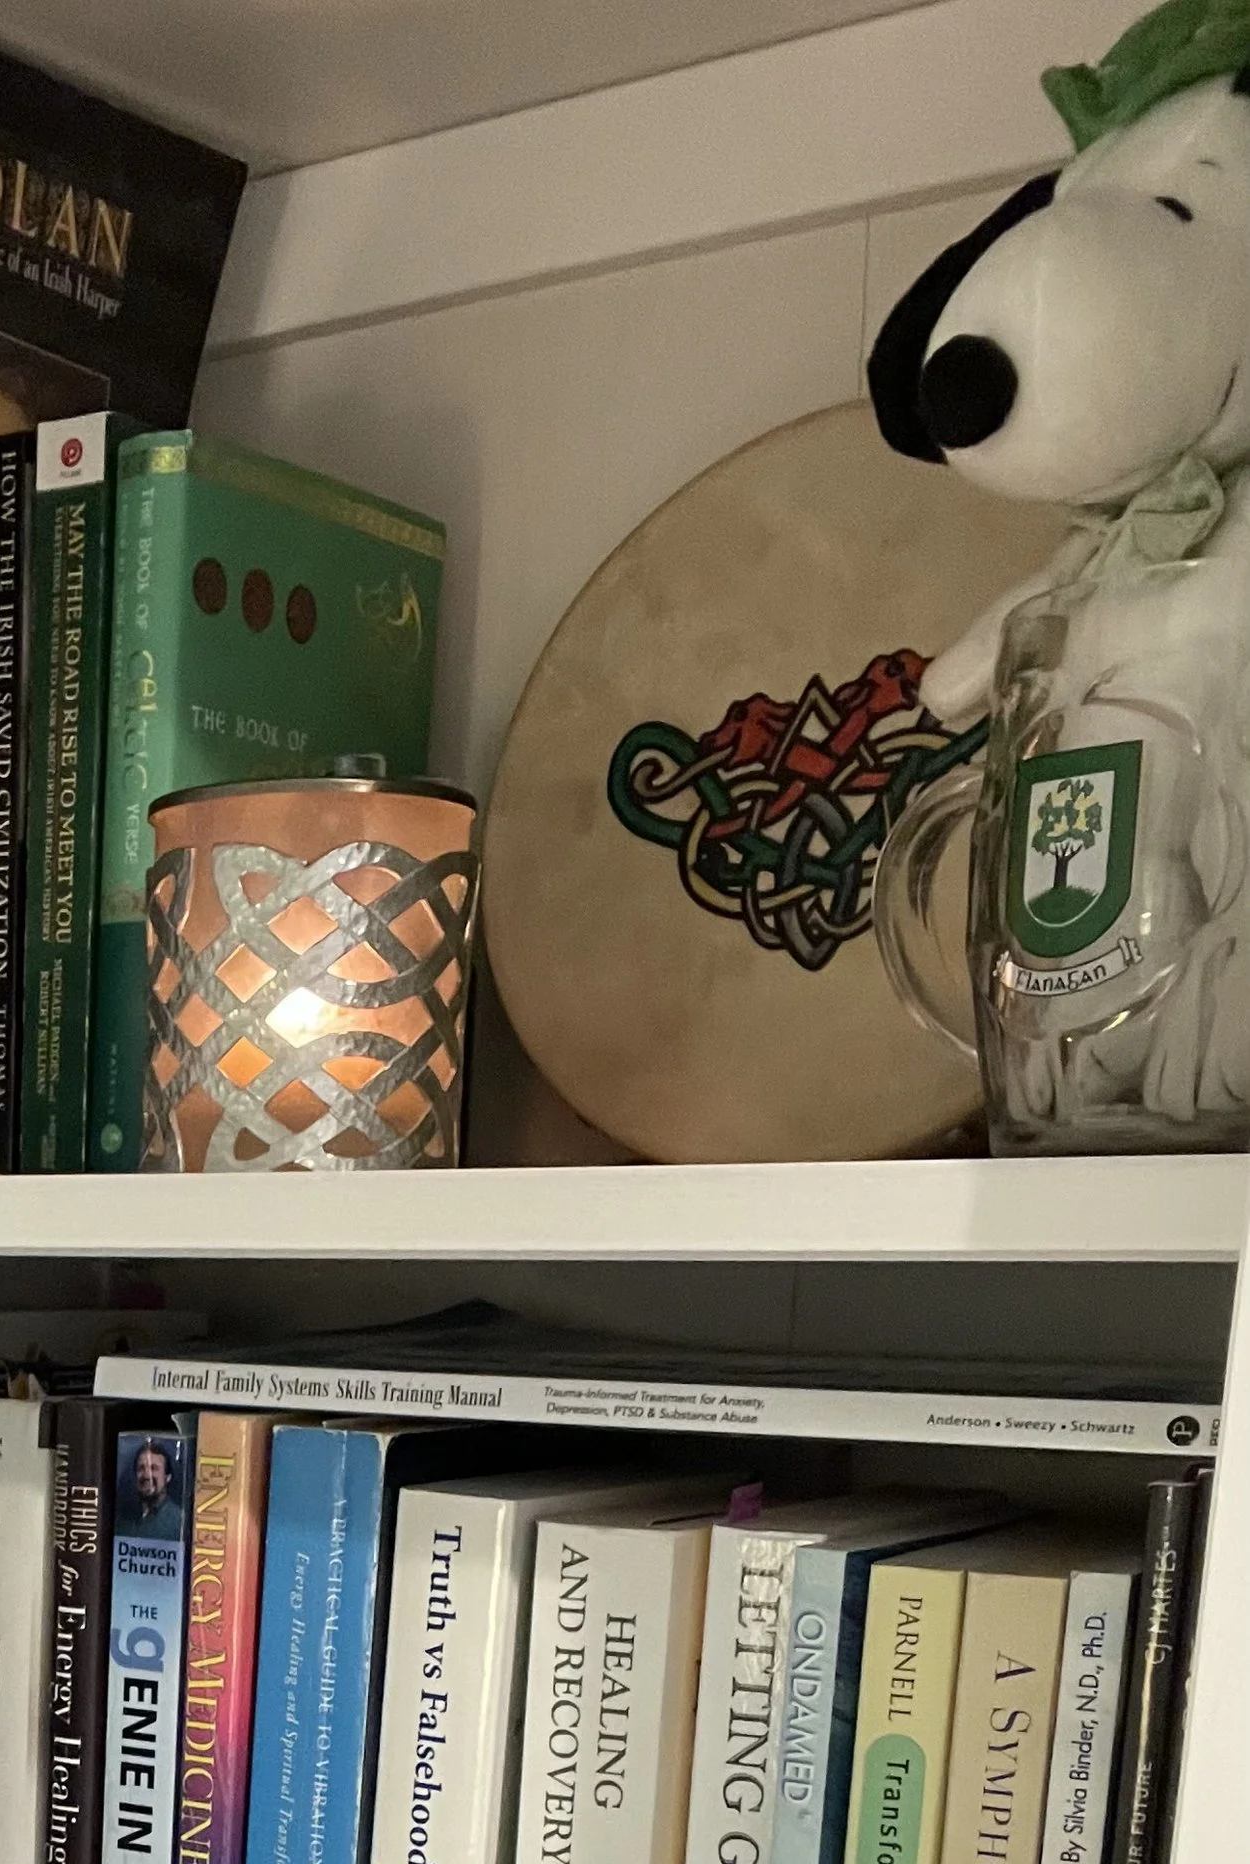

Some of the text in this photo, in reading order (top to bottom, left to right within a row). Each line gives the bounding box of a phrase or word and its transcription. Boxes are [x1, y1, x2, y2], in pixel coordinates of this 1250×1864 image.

[7, 249, 22, 274] of
[23, 260, 40, 282] an
[43, 257, 73, 300] Irish
[76, 273, 123, 319] Harper
[0, 451, 17, 523] HOW
[136, 536, 154, 594] BOOK
[135, 603, 151, 634] OF
[55, 502, 87, 944] MAY THE ROAD RISE TO MEET YOU
[124, 802, 142, 866] VERSE
[1014, 964, 1107, 992] Flanagan
[151, 1366, 503, 1410] Internal Family Systems Skills Training Manual
[544, 1385, 765, 1410] Trauma-Informed Treatment for Anxiety,
[926, 1413, 1136, 1435] Anderson Sweezy Schwartz
[69, 1485, 99, 1554] ETHICS
[118, 1541, 177, 1561] Dawson
[191, 1452, 237, 1635] ENERGY
[57, 1561, 80, 1597] for
[118, 1558, 176, 1578] Church
[290, 1552, 310, 1612] Energy
[324, 1516, 347, 1638] PRACTICAL
[426, 1525, 463, 1632] Truth
[556, 1543, 591, 1633] AND
[1147, 1549, 1177, 1634] MARTES
[130, 1604, 158, 1620] THE
[49, 1605, 87, 1725] Energy
[284, 1617, 306, 1686] Healing
[319, 1644, 338, 1714] GUIDE
[422, 1642, 445, 1680] vs
[887, 1595, 923, 1722] PARNELL
[994, 1650, 1038, 1684] A
[285, 1690, 299, 1725] and
[593, 1613, 638, 1810] HEALING
[721, 1563, 785, 1814] LETTING
[280, 1728, 299, 1804] Spiritual
[316, 1725, 332, 1750] TO
[116, 1801, 153, 1854] IN
[1129, 1760, 1153, 1836] FUTURE
